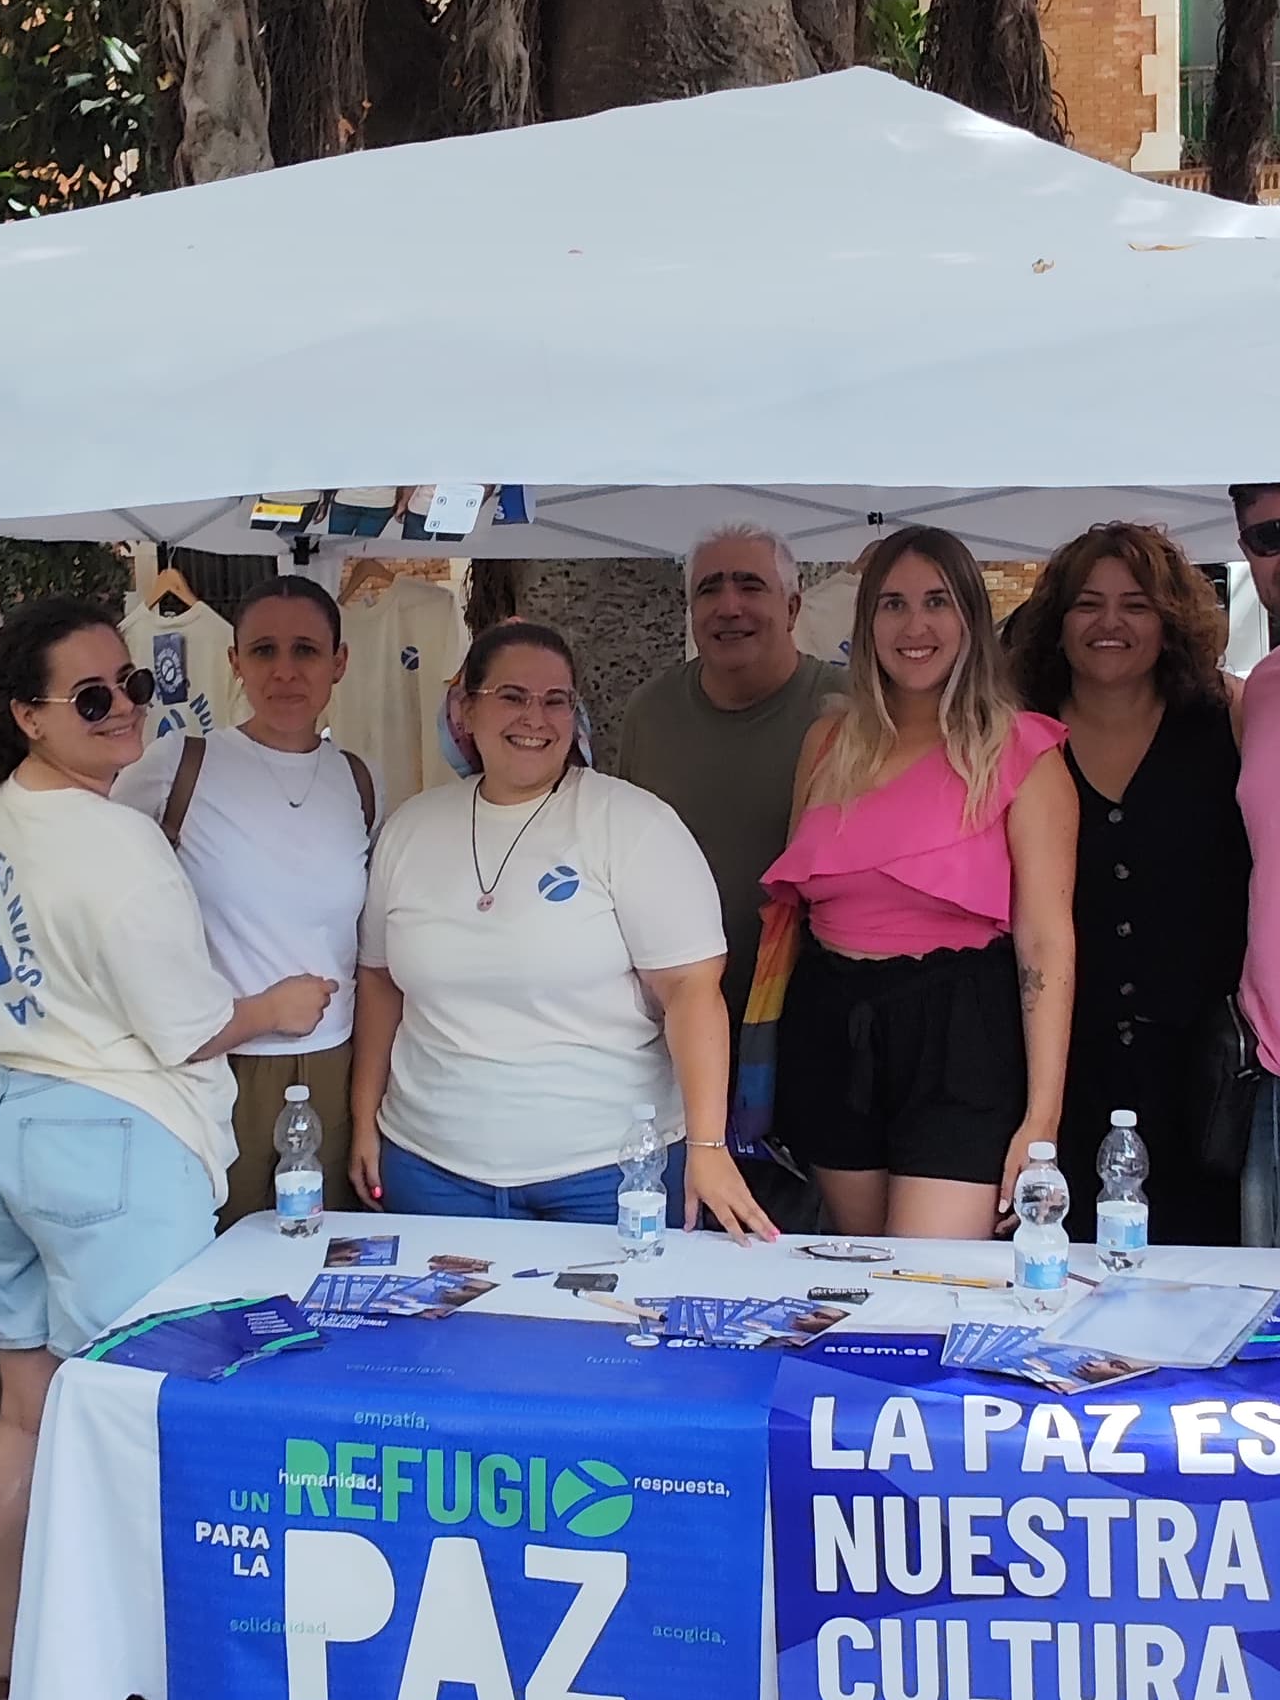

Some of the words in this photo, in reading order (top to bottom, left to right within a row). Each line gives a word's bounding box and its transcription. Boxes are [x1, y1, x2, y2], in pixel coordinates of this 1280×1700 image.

[824, 1346, 928, 1356] accem.es
[353, 1410, 430, 1431] empatía,
[810, 1395, 932, 1471] LA
[964, 1395, 1145, 1473] PAZ
[278, 1469, 382, 1493] humanidad,
[634, 1475, 730, 1497] respuesta,
[230, 1490, 269, 1512] UN
[196, 1522, 269, 1548] PARA
[812, 1495, 1270, 1602] NUESTRA
[233, 1554, 269, 1577] LA
[653, 1624, 726, 1646] acogida,
